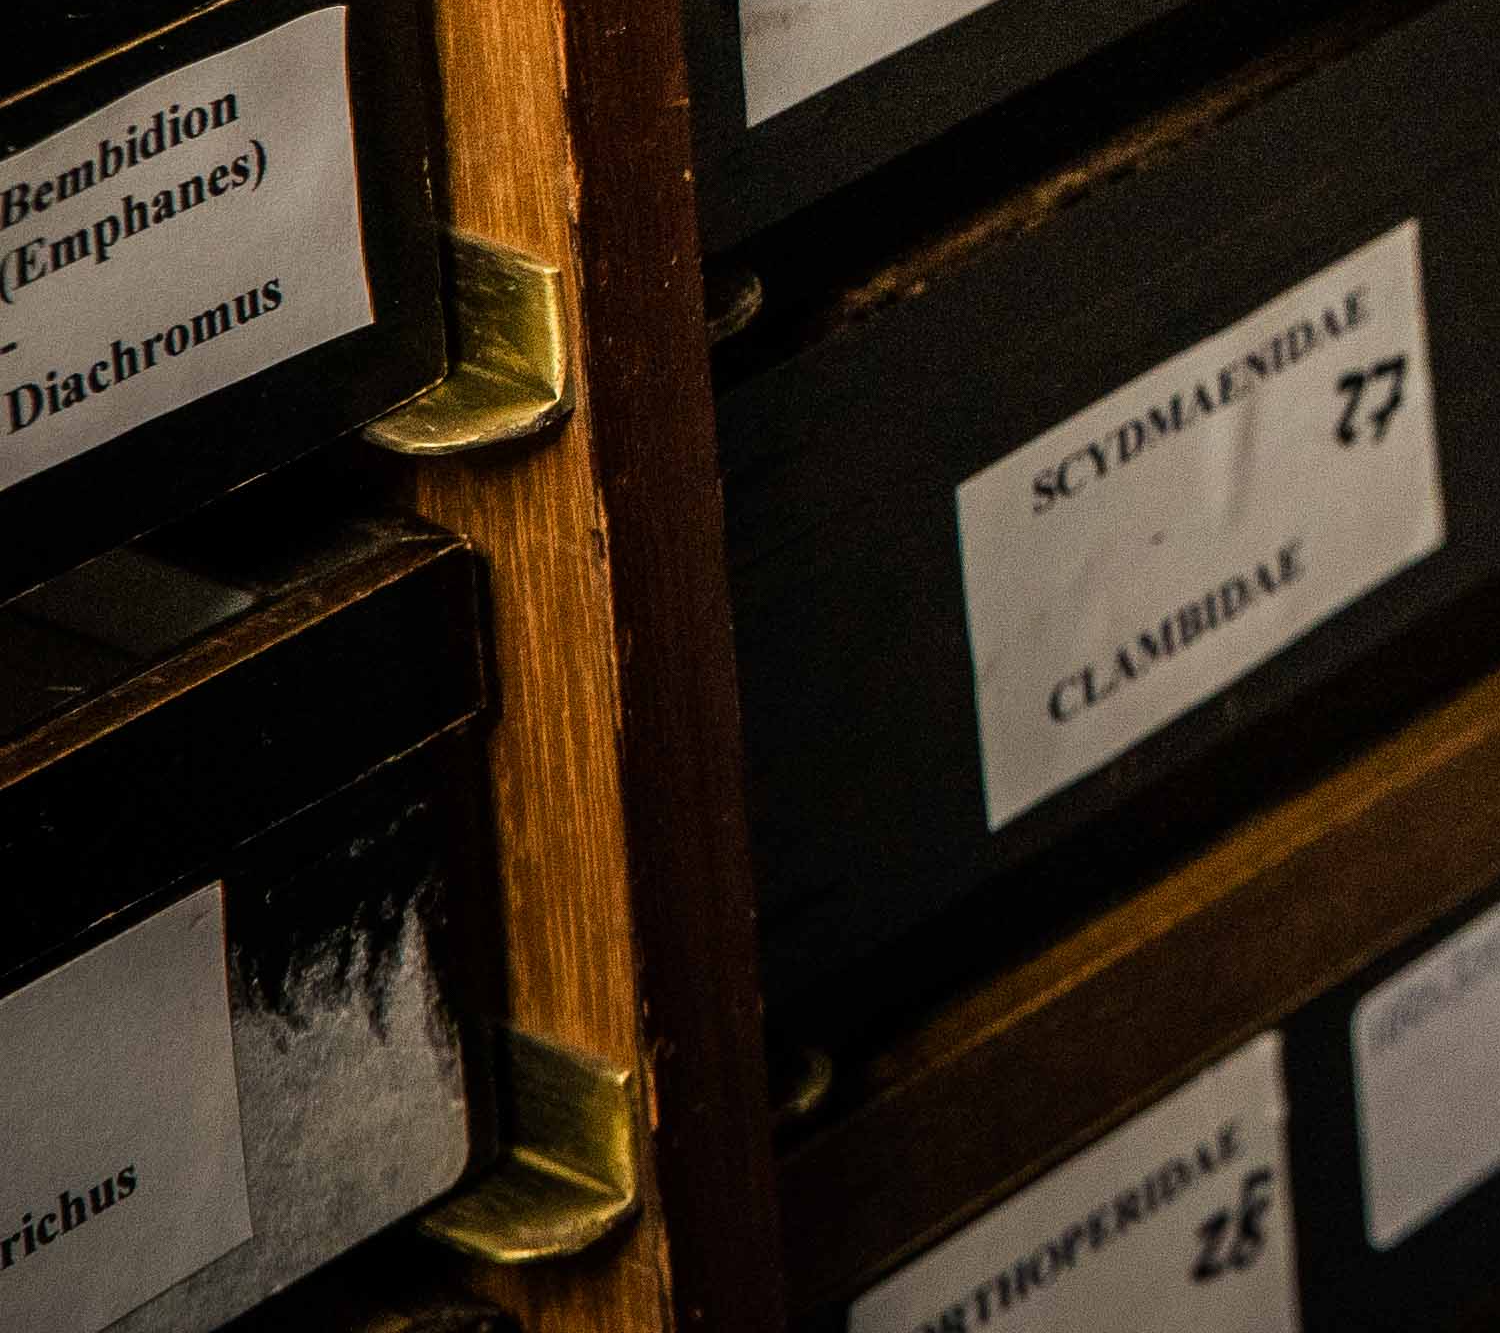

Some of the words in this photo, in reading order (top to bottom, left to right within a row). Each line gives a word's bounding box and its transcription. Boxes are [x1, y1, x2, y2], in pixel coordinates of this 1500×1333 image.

[0, 91, 241, 231] Bembidion
[0, 138, 268, 305] (Emphanes)
[3, 276, 285, 433] Diachromus
[1027, 286, 1372, 518] SCYDMAENIDAE
[1045, 539, 1307, 726] CLAMBIDAE
